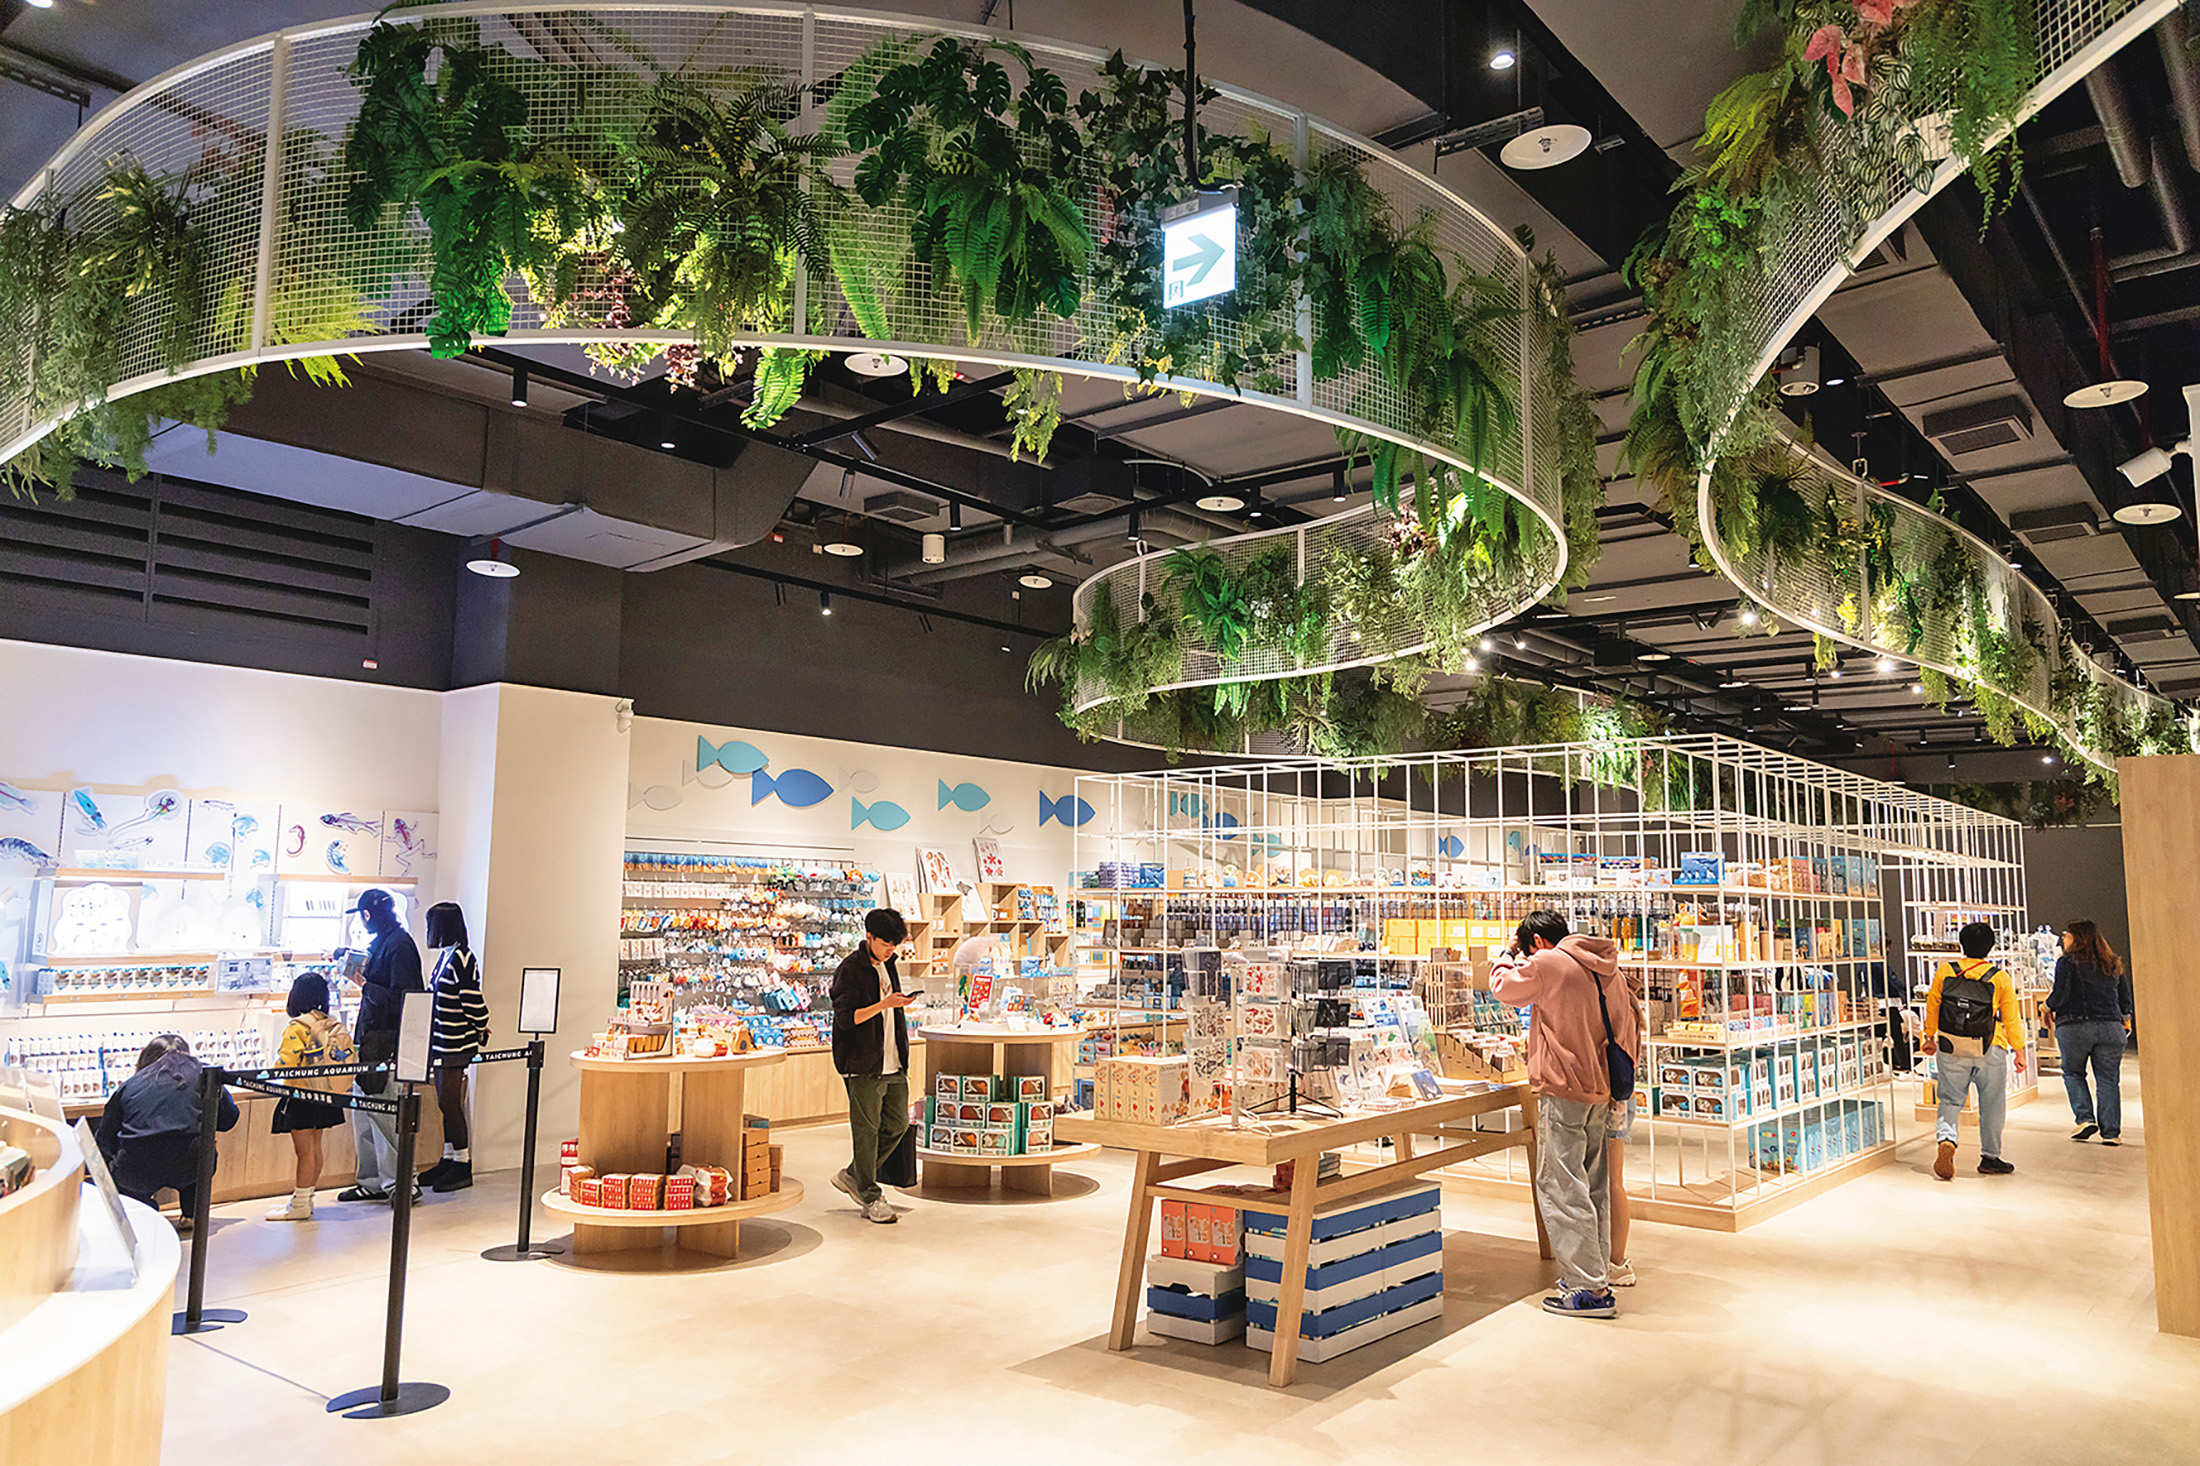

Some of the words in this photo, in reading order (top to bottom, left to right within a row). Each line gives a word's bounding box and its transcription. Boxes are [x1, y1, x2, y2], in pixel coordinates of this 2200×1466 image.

[485, 1050, 521, 1060] TAICHUNG
[274, 1067, 319, 1078] TAICHUNG
[323, 1065, 369, 1076] AQUARIUM
[358, 1100, 386, 1111] TAICHUNG
